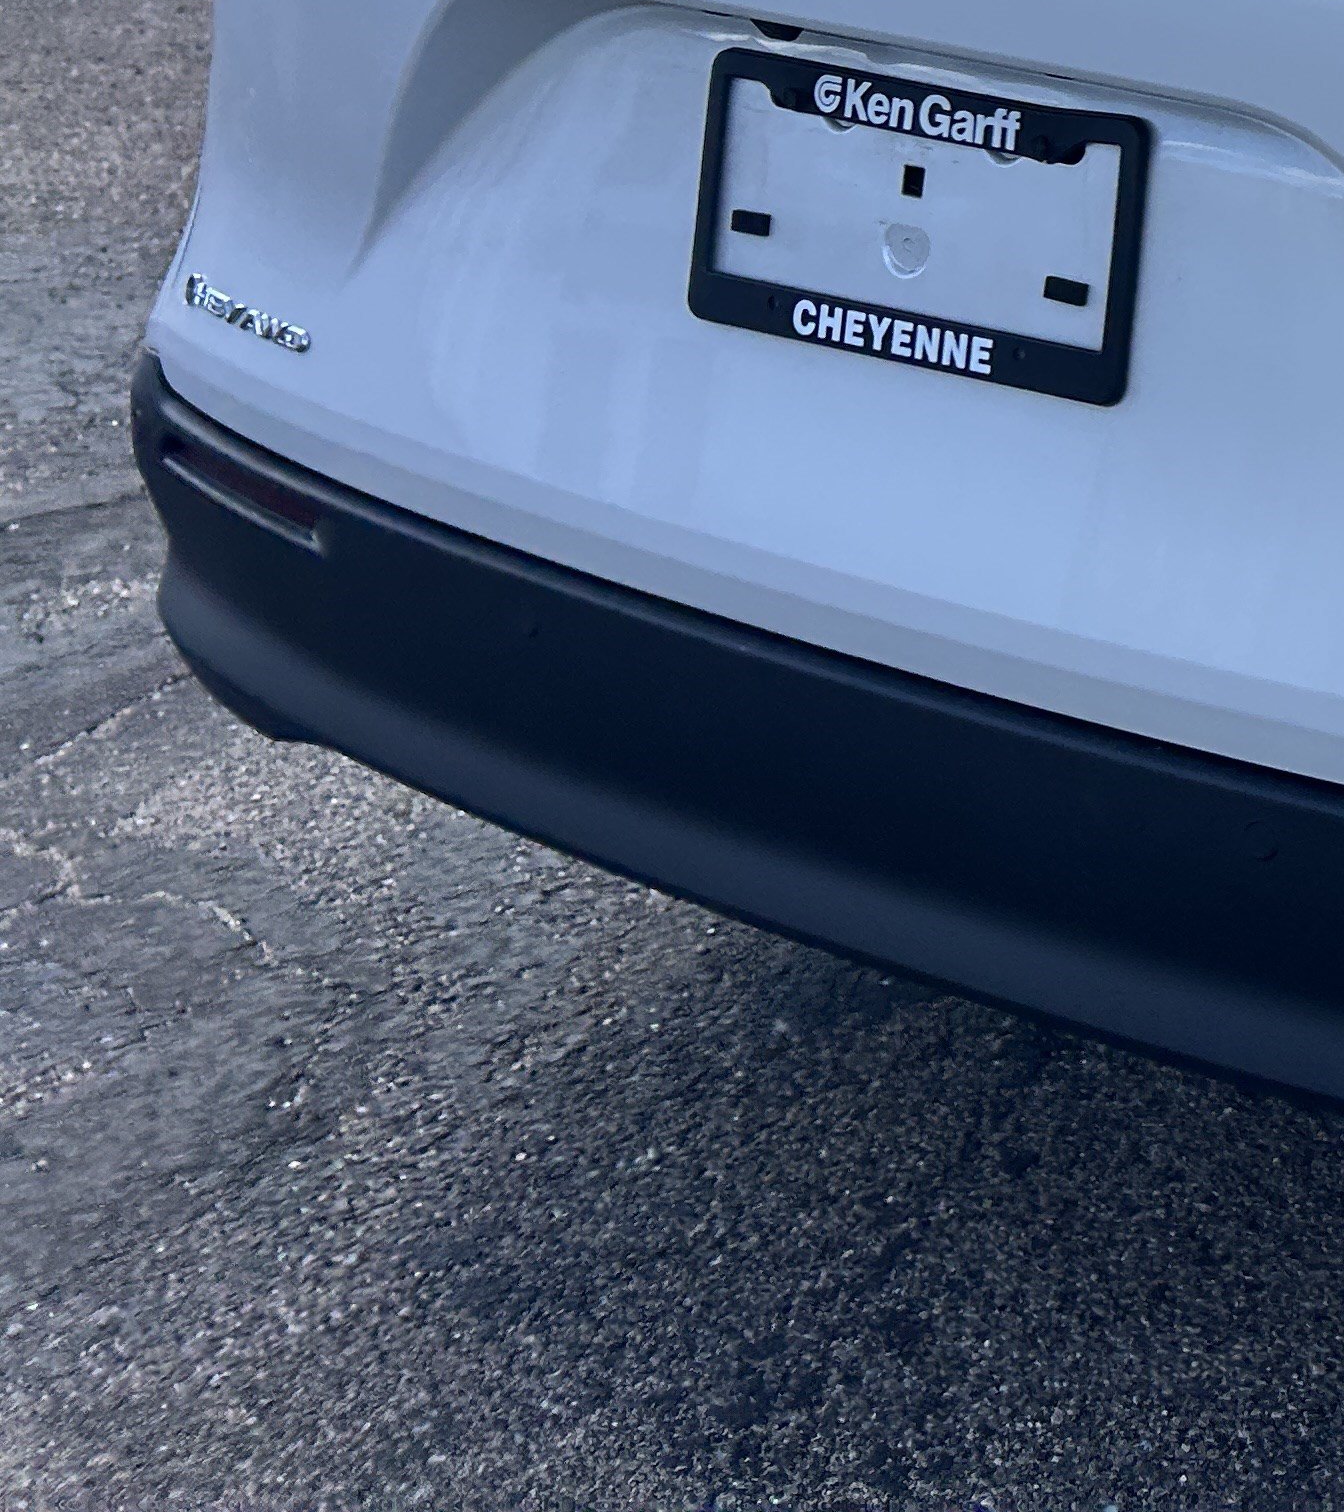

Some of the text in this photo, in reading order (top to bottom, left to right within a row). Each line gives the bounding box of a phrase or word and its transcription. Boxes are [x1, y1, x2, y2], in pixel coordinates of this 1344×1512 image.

[844, 77, 1022, 152] Ken Garff
[793, 299, 994, 375] CHEYENNE
